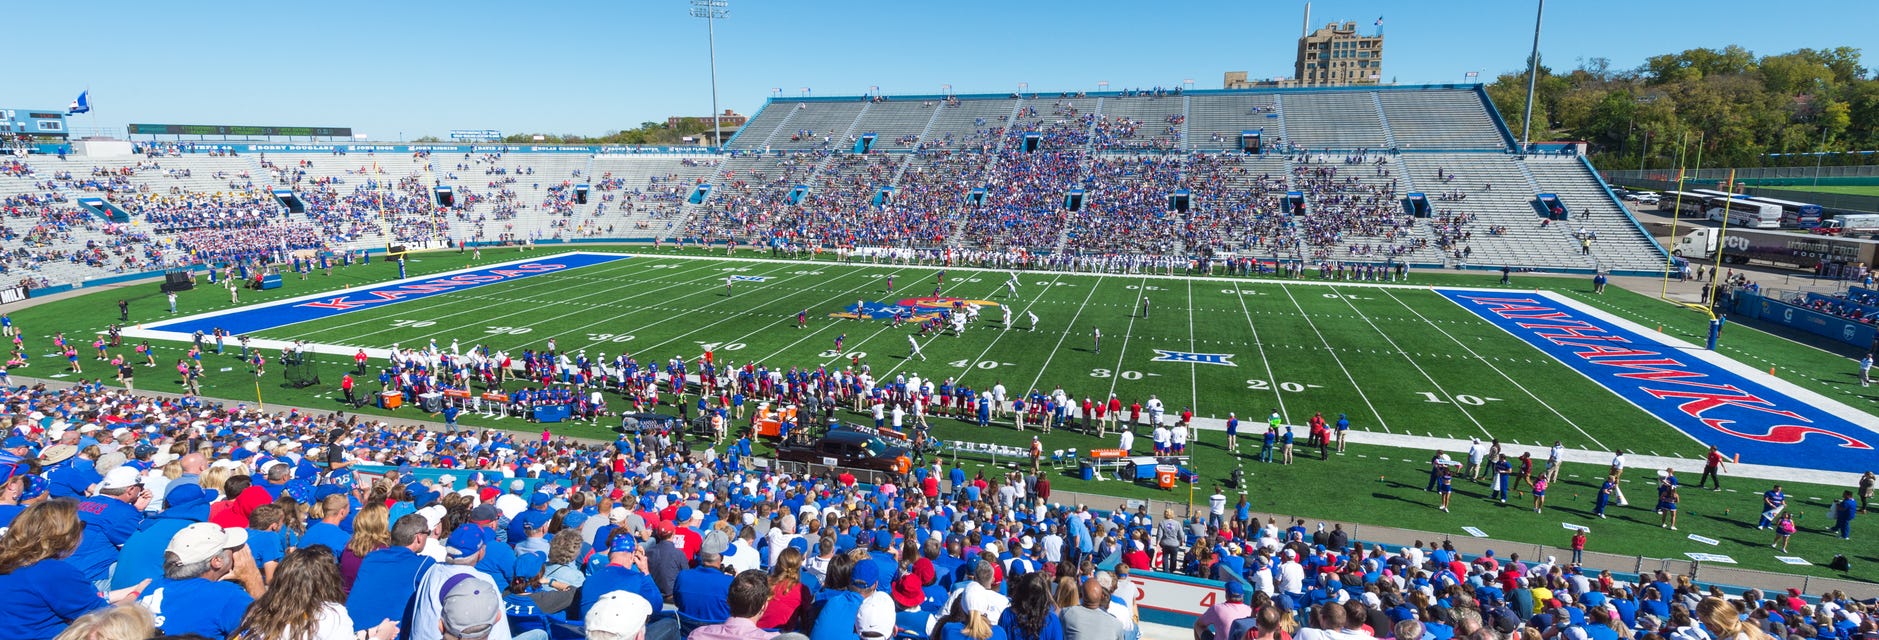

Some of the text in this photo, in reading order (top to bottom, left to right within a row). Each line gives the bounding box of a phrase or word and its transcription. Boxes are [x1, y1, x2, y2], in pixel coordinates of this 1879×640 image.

[293, 262, 567, 311] KANSAS
[948, 359, 999, 370] 40
[1089, 368, 1144, 381] 30
[1457, 294, 1875, 451] JAYHAWKS
[1246, 379, 1305, 393] 20
[1415, 390, 1487, 406] 10
[1161, 473, 1171, 484] G
[1200, 592, 1217, 608] 4
